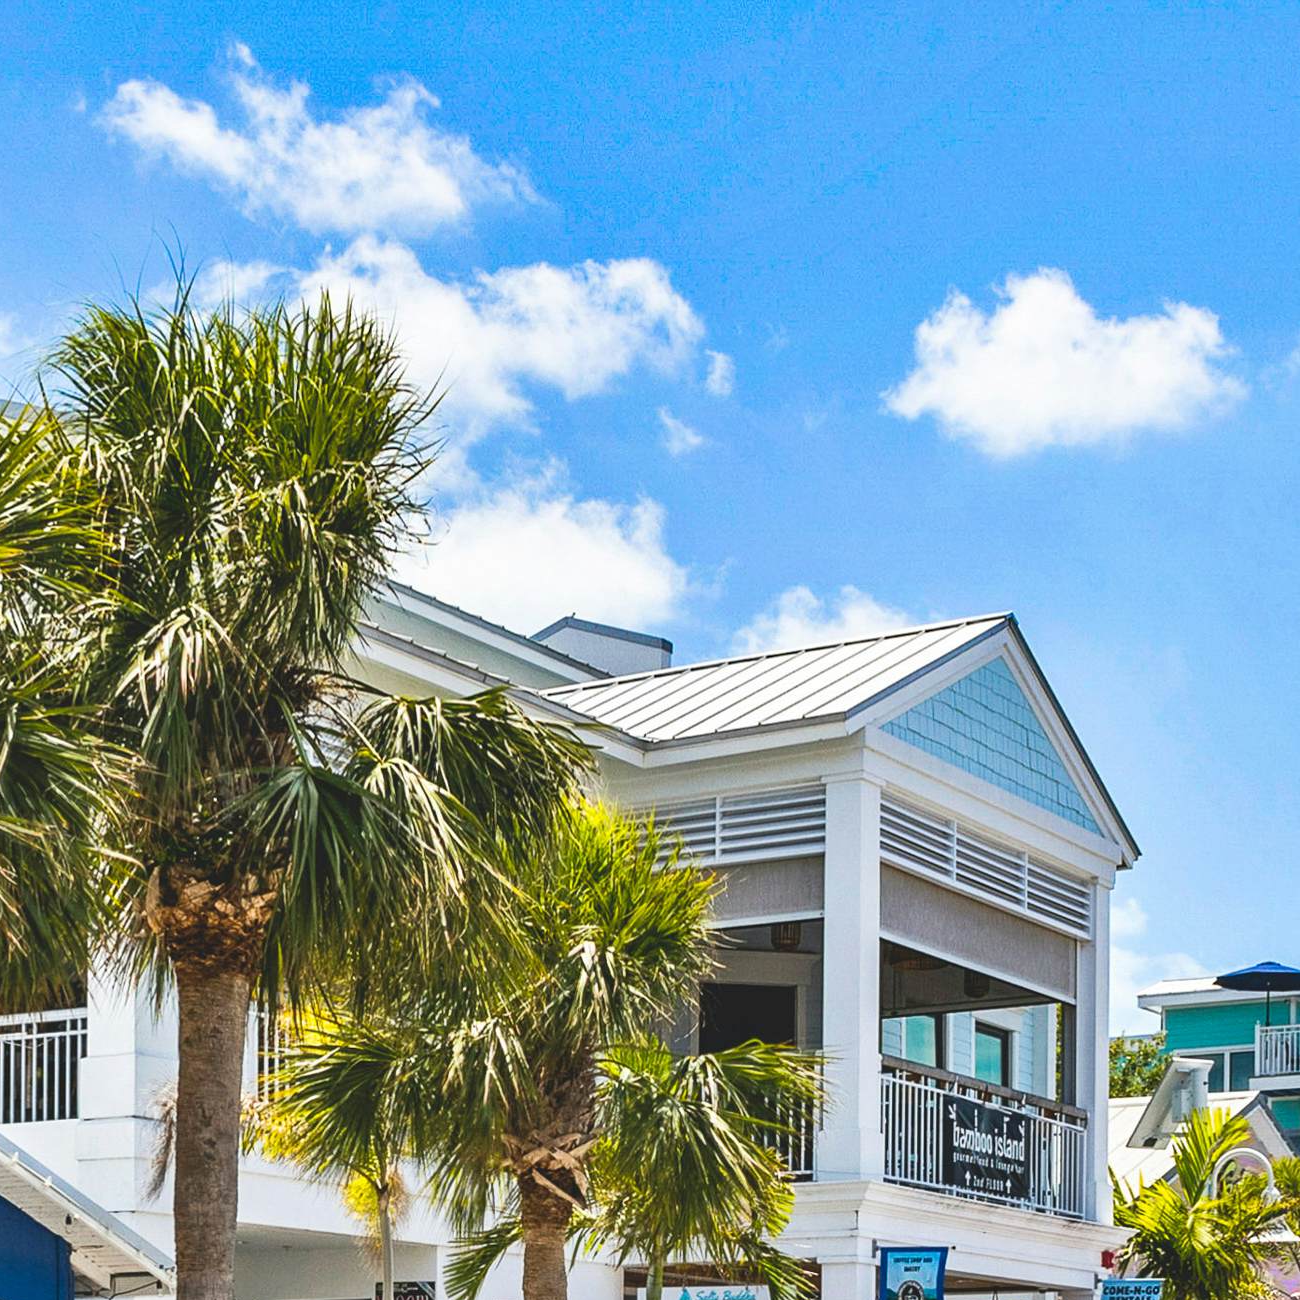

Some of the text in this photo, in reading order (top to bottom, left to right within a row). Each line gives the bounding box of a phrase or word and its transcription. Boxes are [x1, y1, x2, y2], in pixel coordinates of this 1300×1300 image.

[952, 1114, 1025, 1161] bamboo island
[1103, 1286, 1160, 1296] COME-N-GO
